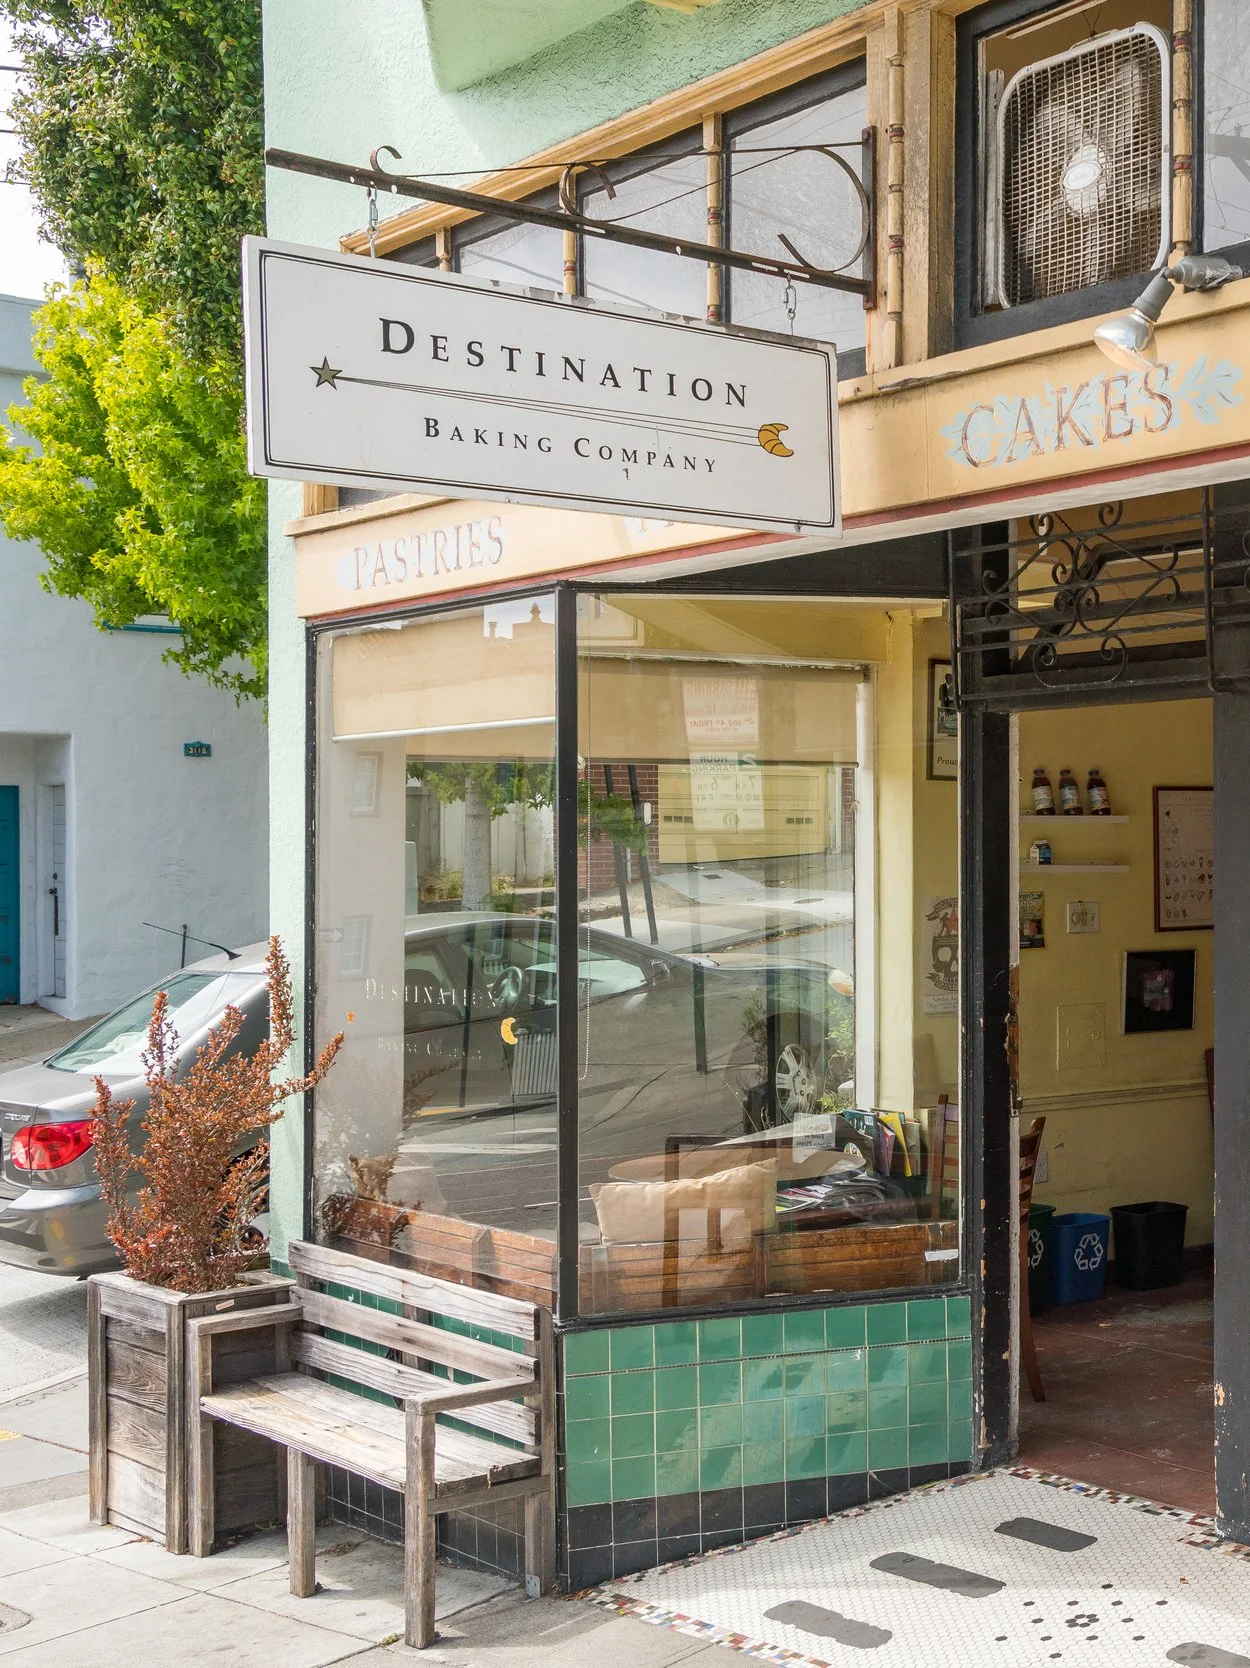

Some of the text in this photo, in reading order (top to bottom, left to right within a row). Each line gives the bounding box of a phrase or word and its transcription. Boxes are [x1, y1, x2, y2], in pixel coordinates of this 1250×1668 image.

[379, 317, 750, 409] DESTINATION
[424, 416, 719, 475] BAKING COMPANY
[960, 362, 1175, 469] CAKES
[352, 515, 507, 592] PASTRIES
